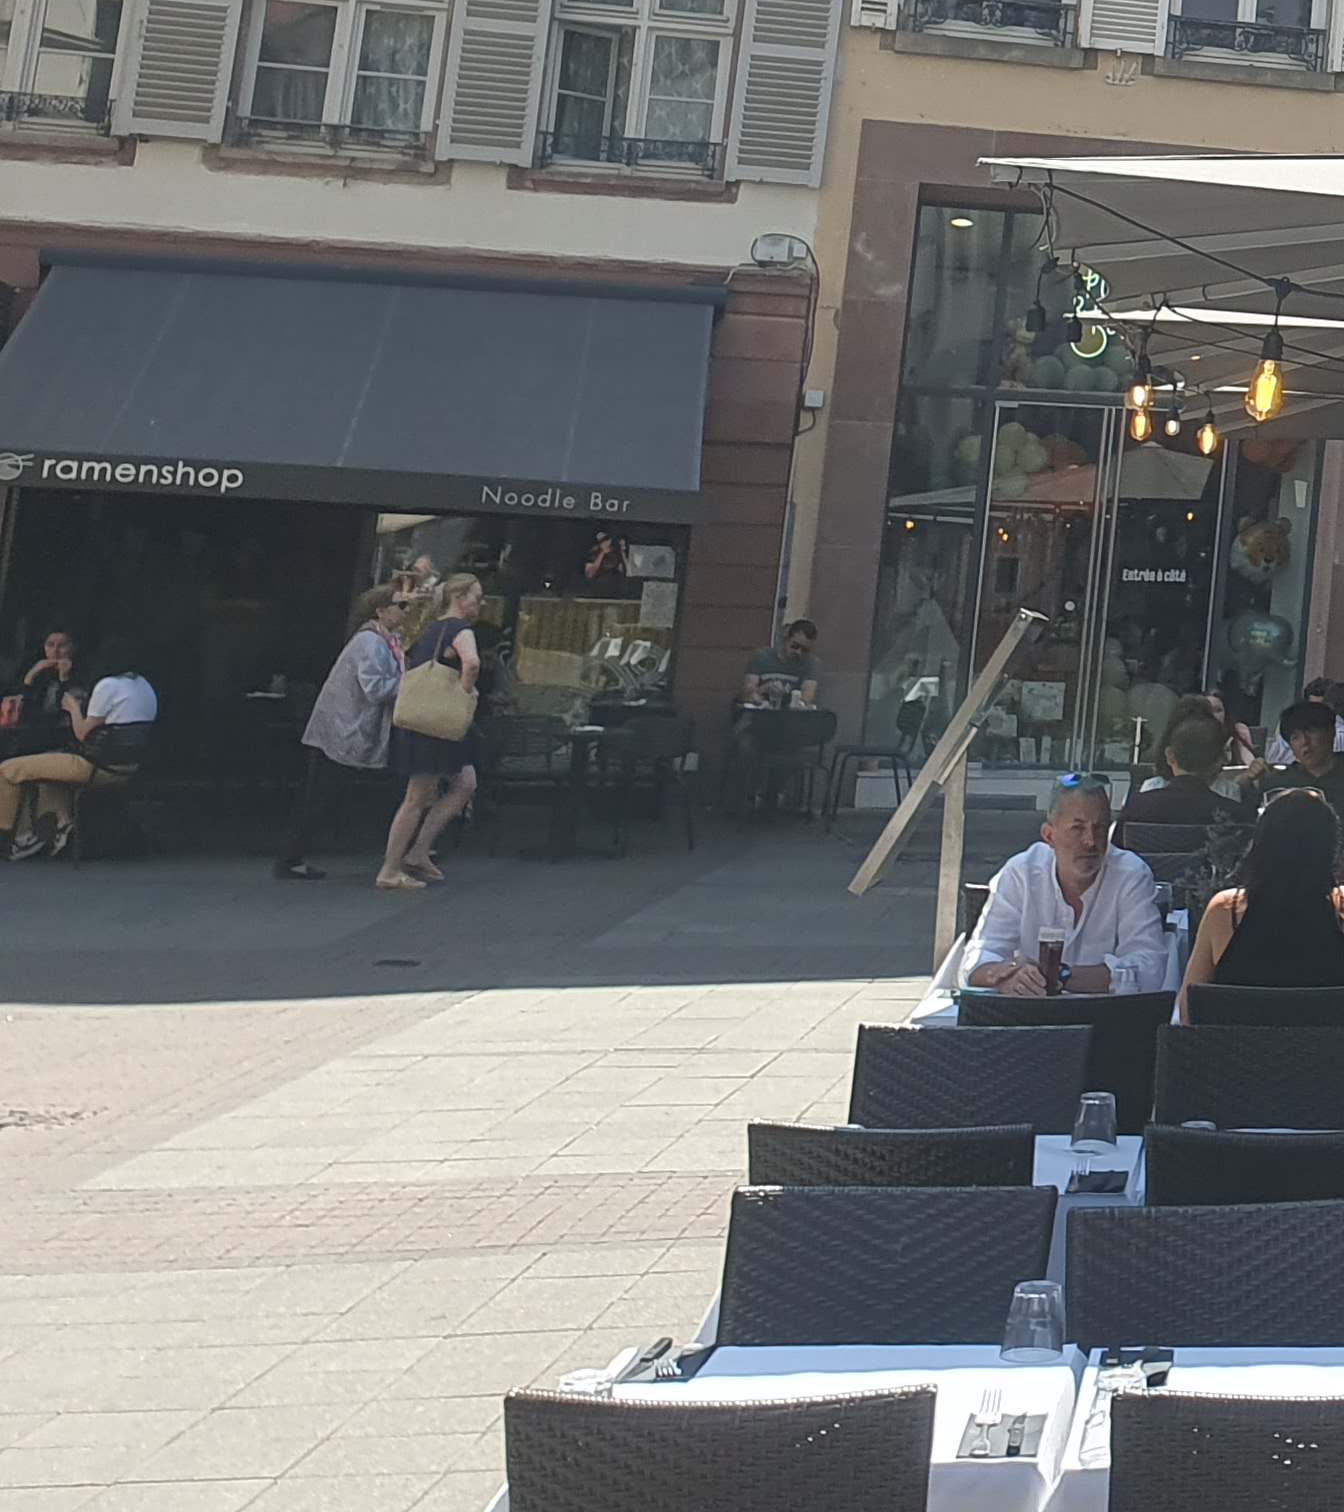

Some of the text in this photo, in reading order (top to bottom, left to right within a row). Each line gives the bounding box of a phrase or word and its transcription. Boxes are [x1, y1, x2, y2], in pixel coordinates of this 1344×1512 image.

[41, 457, 245, 494] ramenshop
[481, 485, 631, 513] Noodle Bar
